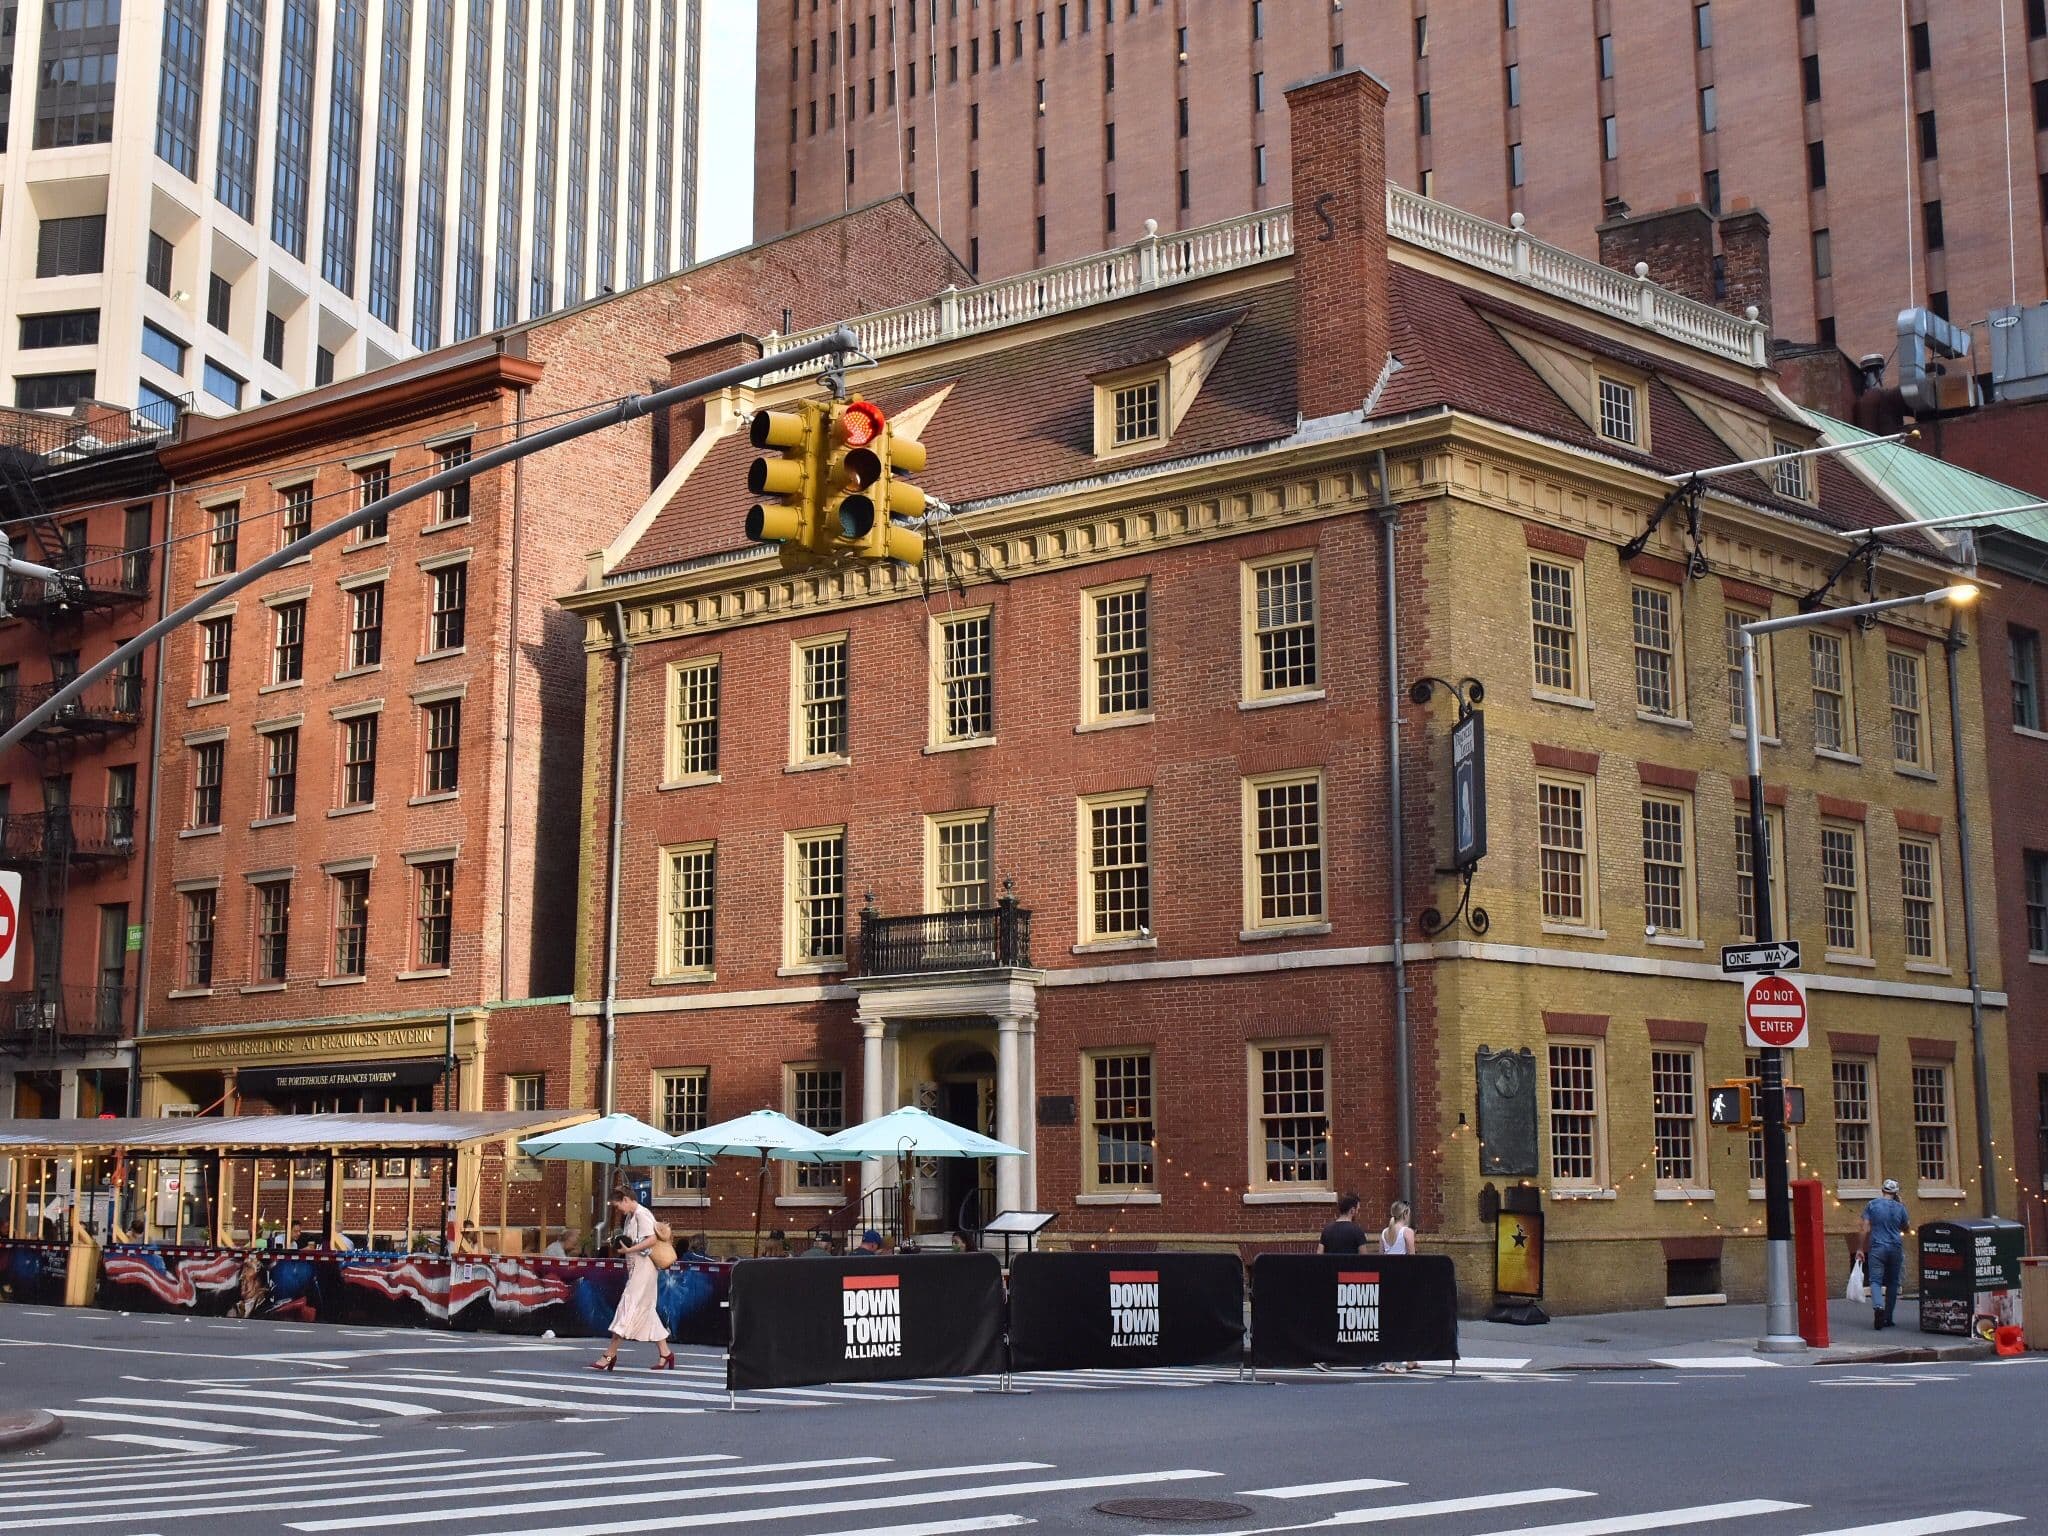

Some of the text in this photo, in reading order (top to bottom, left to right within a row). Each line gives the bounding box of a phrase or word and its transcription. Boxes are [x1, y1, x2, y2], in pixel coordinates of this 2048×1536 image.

[1728, 950, 1789, 965] ONE WAY
[1756, 990, 1794, 1001] DO NOT
[1760, 1021, 1794, 1032] ENTER
[192, 1043, 212, 1058] THE
[216, 1038, 295, 1057] PORTERHOUSE
[302, 1036, 318, 1050] AT
[320, 1031, 381, 1049] FRAUNCES
[277, 1077, 288, 1086] THE
[288, 1075, 329, 1086] PORTERHOUSE
[329, 1074, 337, 1084] AT
[337, 1073, 368, 1083] FRAUNCES
[1975, 1237, 1992, 1247] SHOP
[1975, 1246, 1997, 1257] WHERE
[1975, 1257, 1992, 1267] YOUR
[1975, 1265, 2003, 1277] HEART IS
[1110, 1283, 1159, 1308] DOWN
[1337, 1283, 1380, 1306] DOWN
[843, 1289, 900, 1317] DOWN
[1111, 1308, 1160, 1333] TOWN
[1336, 1307, 1379, 1330] TOWN
[843, 1316, 901, 1344] TOWN
[1336, 1330, 1380, 1343] ALLIANCE
[1110, 1333, 1159, 1347] ALLIANCE
[844, 1343, 902, 1360] ALLIANCE
